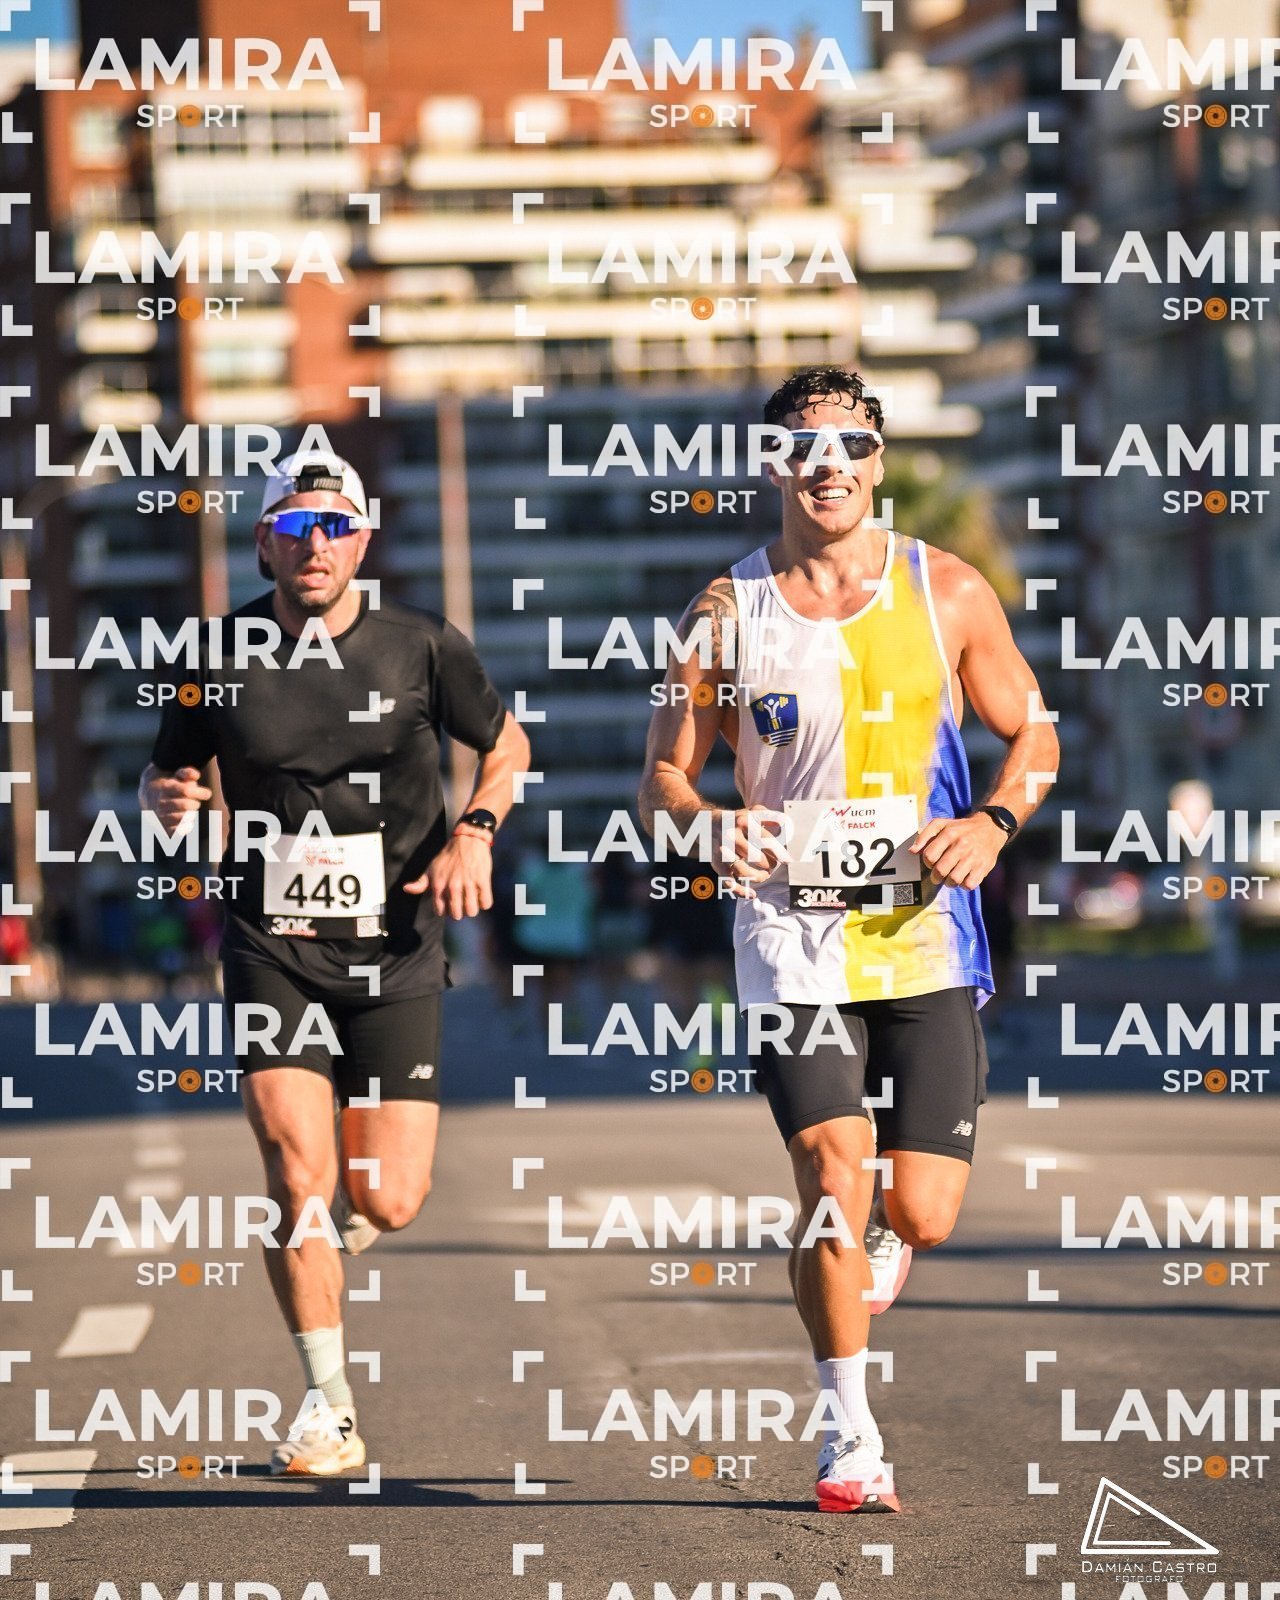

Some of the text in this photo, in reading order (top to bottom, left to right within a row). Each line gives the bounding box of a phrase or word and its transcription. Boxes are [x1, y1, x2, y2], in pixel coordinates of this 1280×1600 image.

[851, 809, 876, 817] ucm
[812, 838, 896, 878] 182
[283, 873, 361, 909] 449
[797, 888, 842, 908] 30K
[271, 916, 314, 935] 30K
